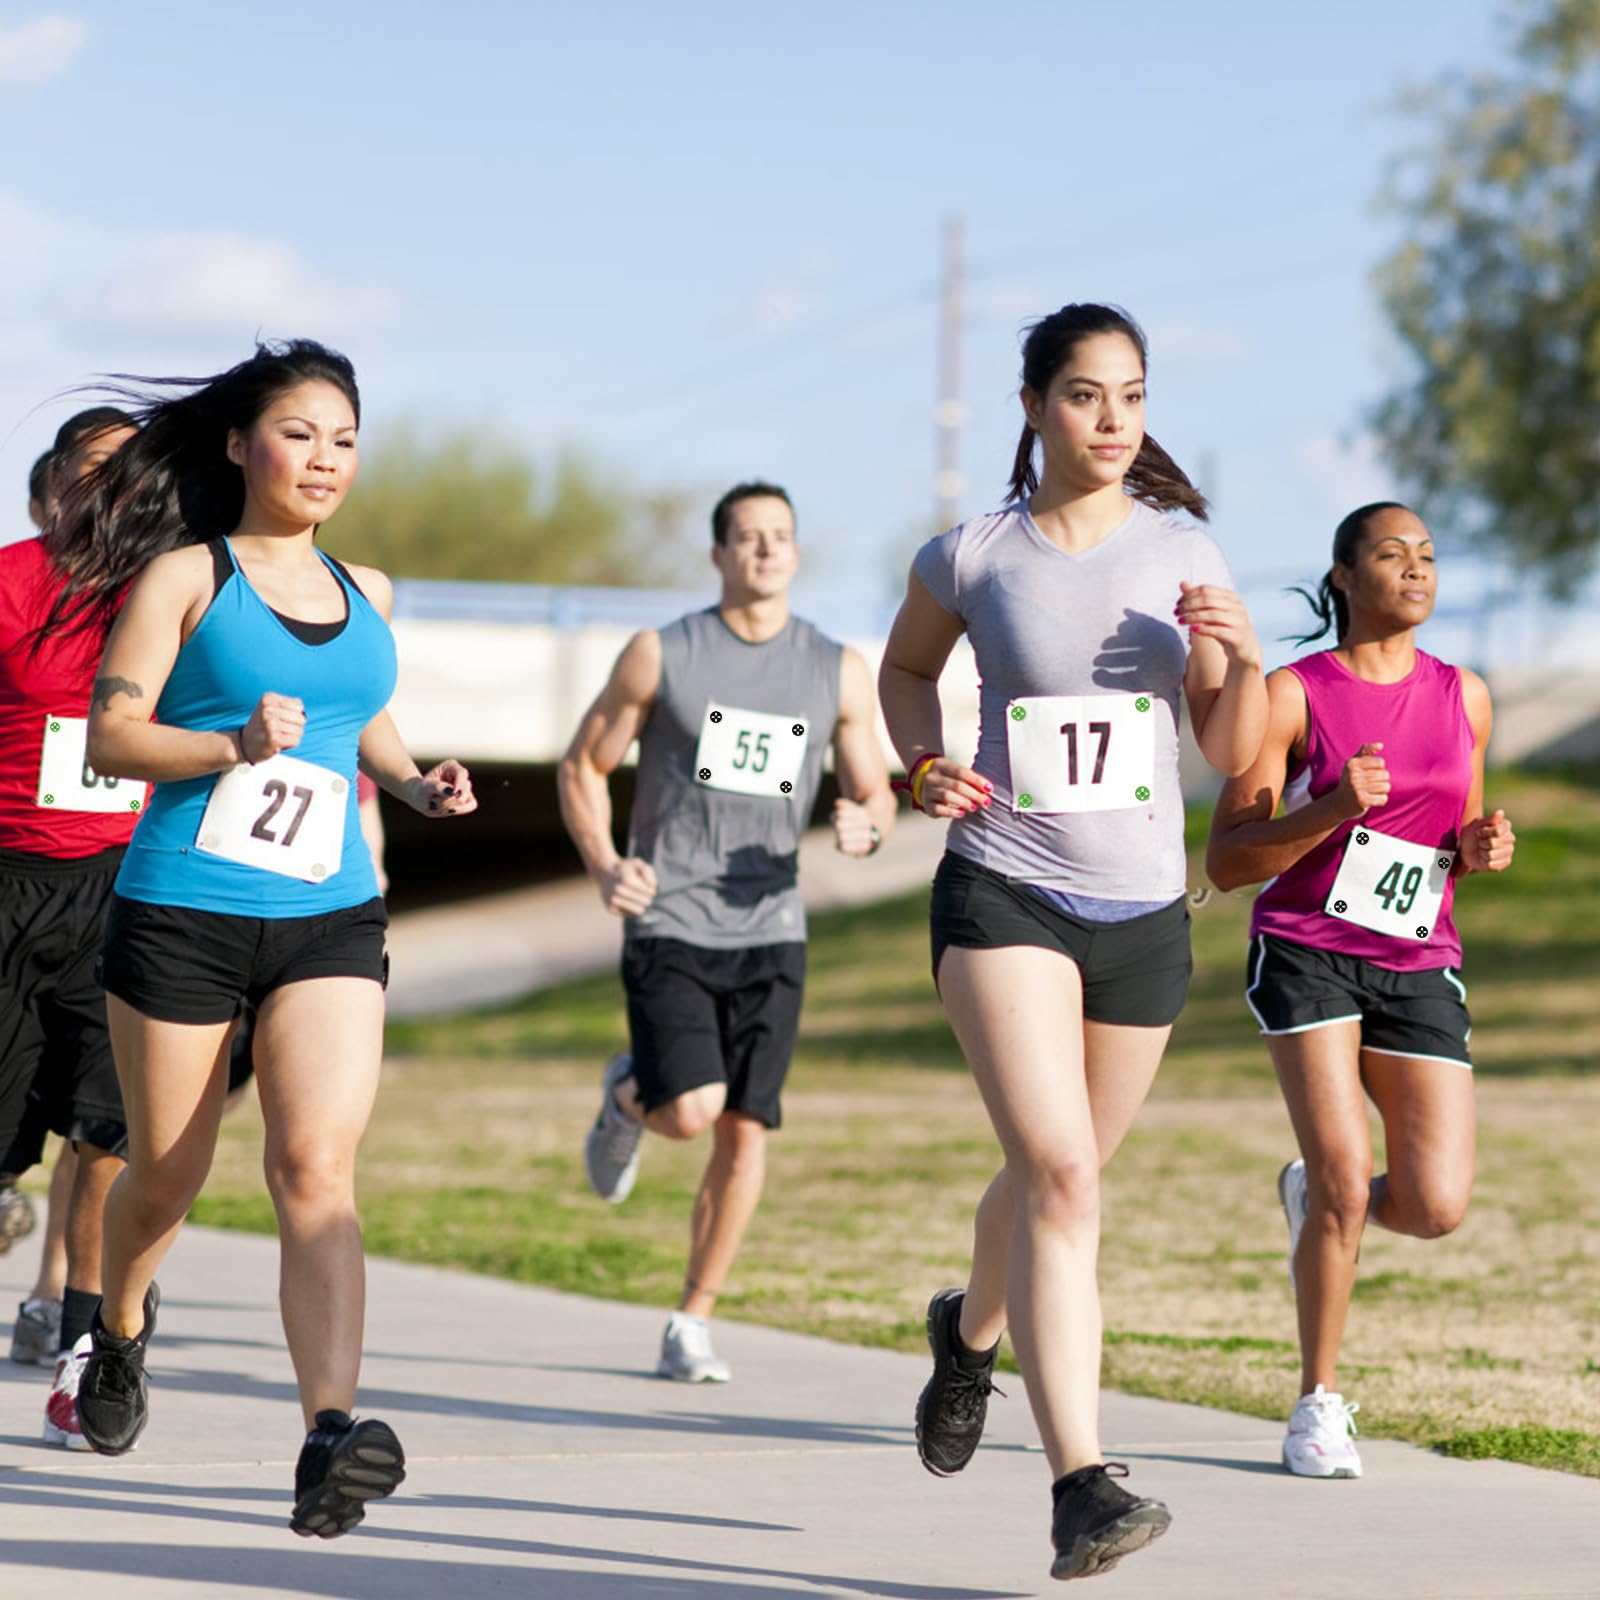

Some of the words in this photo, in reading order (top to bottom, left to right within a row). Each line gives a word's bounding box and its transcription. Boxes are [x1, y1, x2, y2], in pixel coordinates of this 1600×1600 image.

[732, 730, 772, 773] 55
[1059, 721, 1111, 786] 17
[250, 778, 314, 847] 27
[1373, 861, 1424, 915] 49
